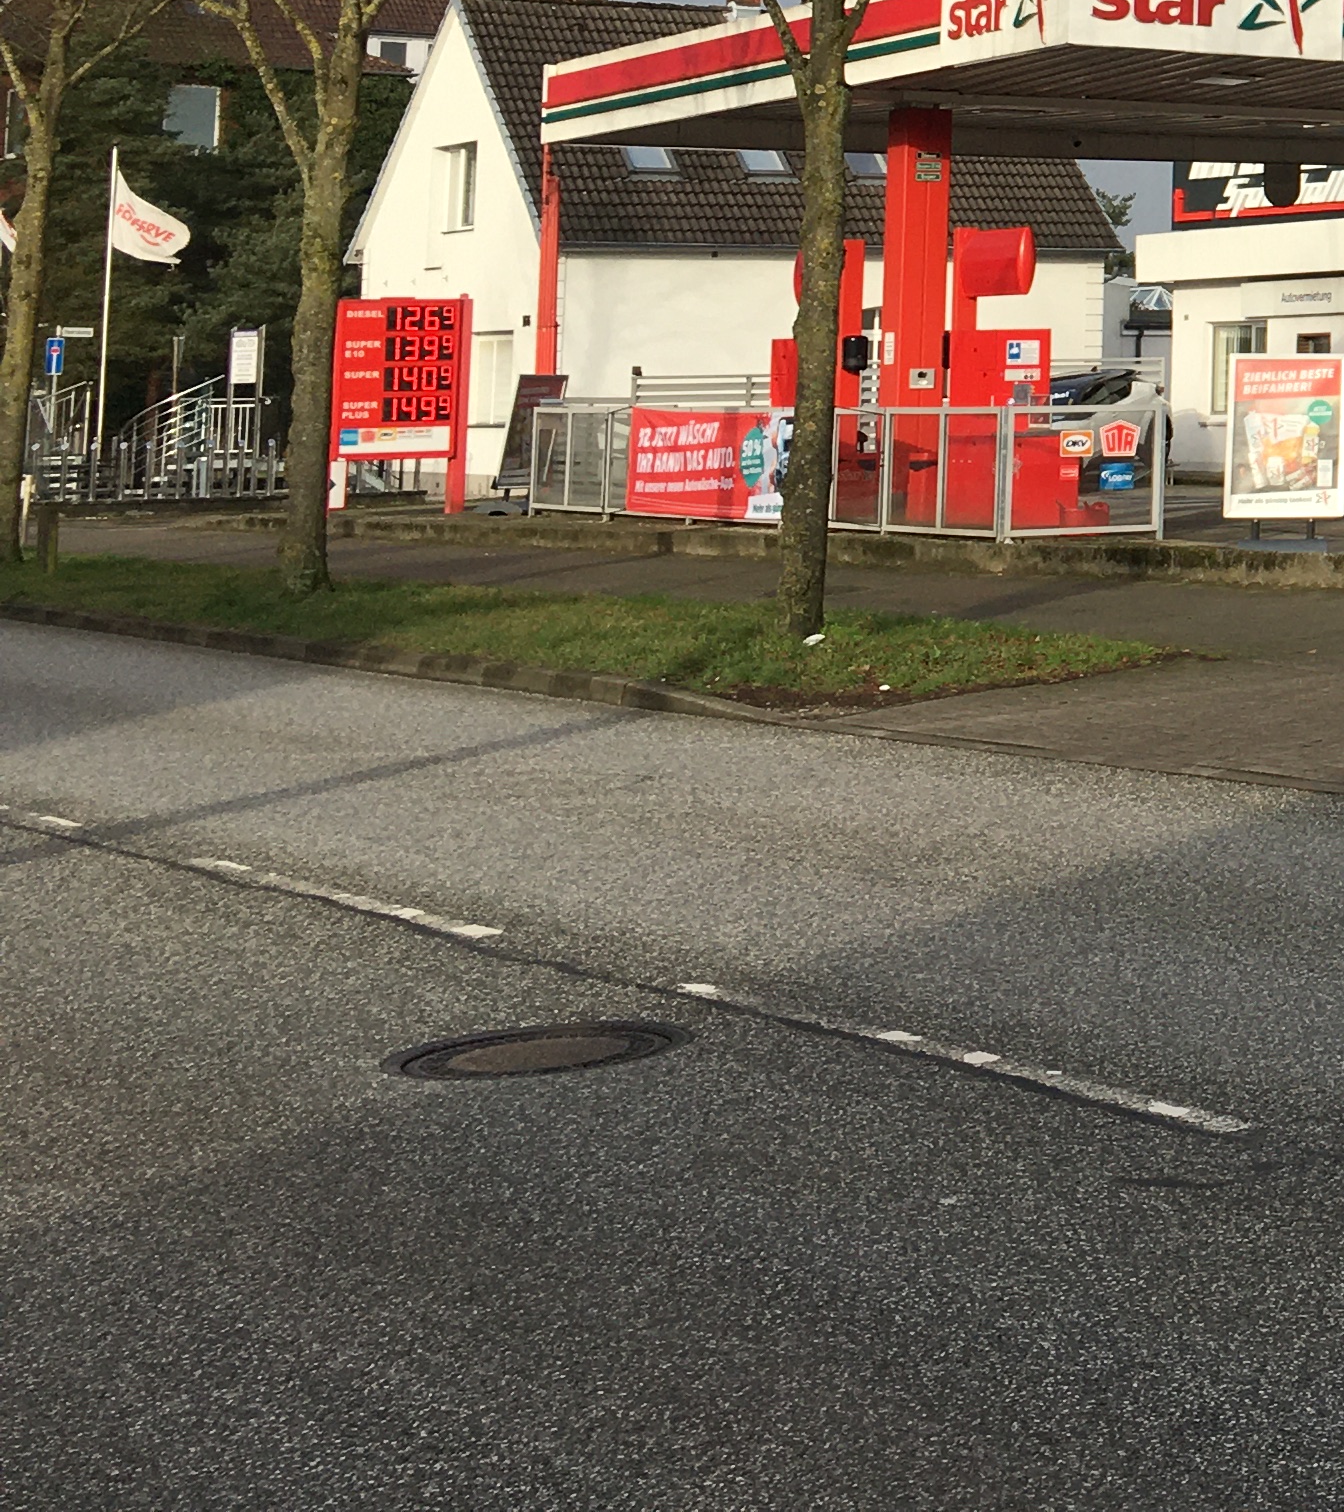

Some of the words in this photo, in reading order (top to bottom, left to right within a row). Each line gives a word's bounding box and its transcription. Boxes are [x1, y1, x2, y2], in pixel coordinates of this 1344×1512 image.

[1281, 290, 1332, 303] Autovermietung
[346, 310, 384, 318] DIESEL
[396, 306, 455, 331] 1269
[345, 340, 381, 349] SUPER
[394, 335, 453, 361] 1399
[344, 370, 380, 379] SUPER
[392, 366, 452, 391] 1409
[1243, 370, 1297, 382] ZIEMLICH
[1300, 368, 1334, 380] BESTE
[1243, 382, 1312, 395] BEIFAHRER!
[342, 401, 379, 410] SUPER
[391, 396, 451, 421] 1499
[342, 411, 370, 419] PLUS
[678, 419, 720, 446] WÄSCHT
[1105, 424, 1136, 452] UTA
[1065, 439, 1088, 447] DKV
[636, 451, 653, 473] IHR
[686, 449, 705, 472] DAS
[706, 446, 736, 471] AUTO.
